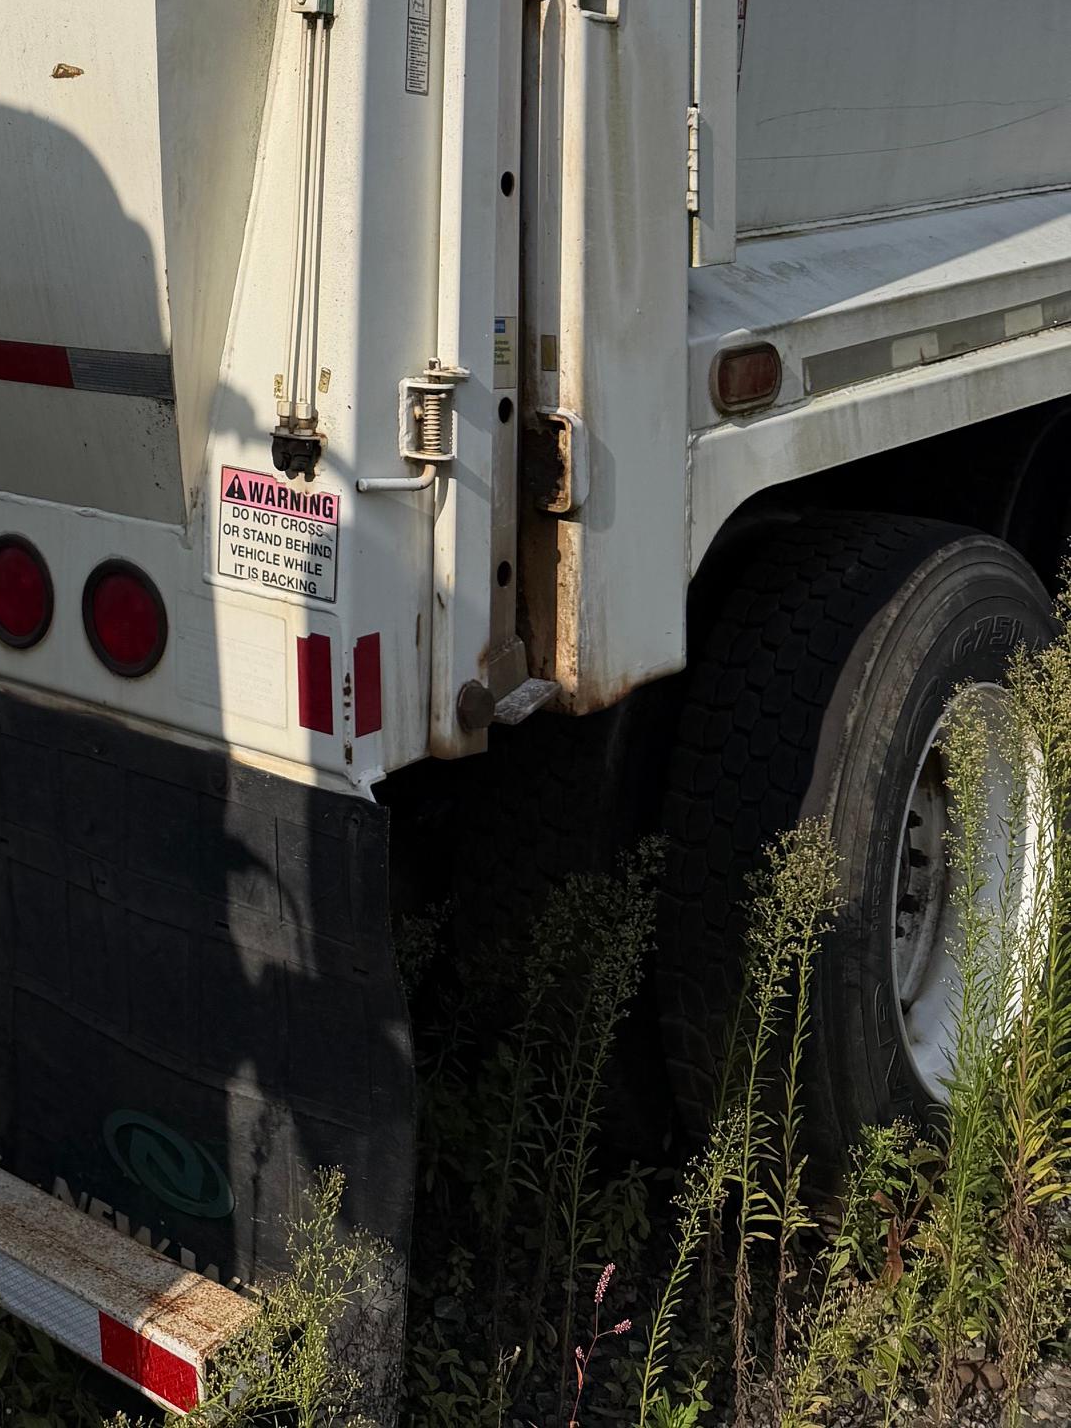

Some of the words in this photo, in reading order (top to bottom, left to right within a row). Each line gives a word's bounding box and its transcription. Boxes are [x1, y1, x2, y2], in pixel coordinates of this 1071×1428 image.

[248, 480, 334, 519] WARNING
[232, 506, 249, 520] DO
[253, 512, 278, 527] NOT
[281, 517, 323, 537] CROSS
[223, 523, 240, 537] OR
[243, 529, 282, 547] STAND
[286, 538, 332, 559] BEHIND
[231, 543, 280, 566] VEHICLE
[283, 555, 322, 576] WHILE
[234, 563, 245, 575] IT
[248, 567, 259, 579] IS
[262, 572, 317, 594] BACKING
